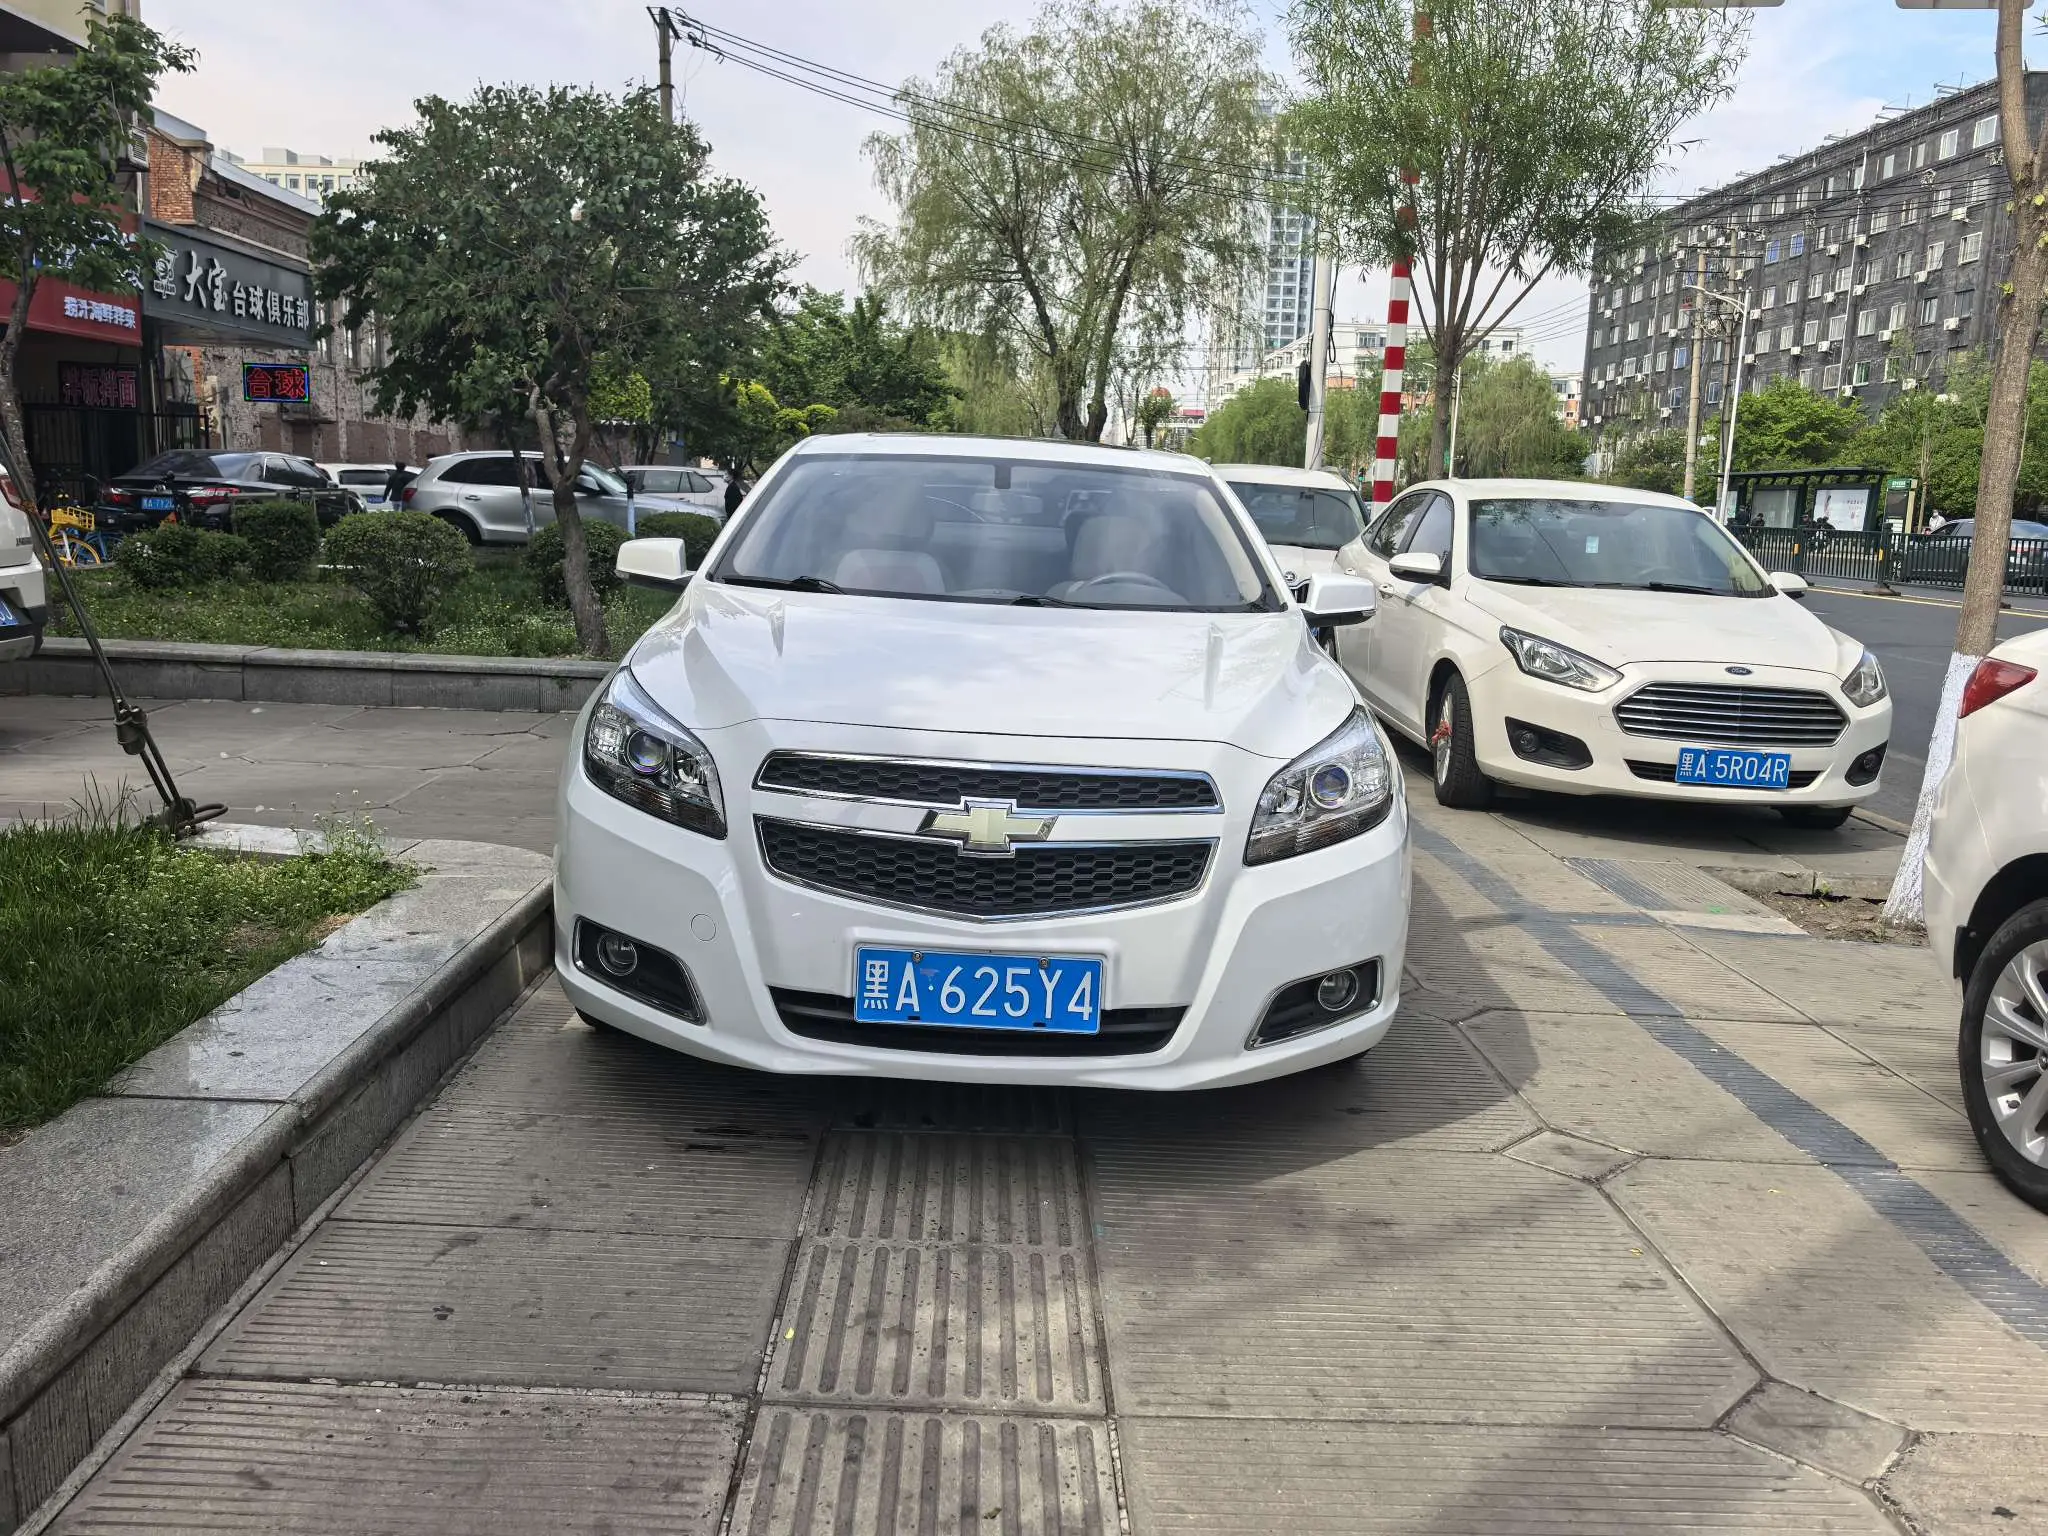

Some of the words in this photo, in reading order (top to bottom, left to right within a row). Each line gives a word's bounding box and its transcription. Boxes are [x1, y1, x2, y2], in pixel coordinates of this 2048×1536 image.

[184, 249, 310, 331] 大宝台球俱乐部
[246, 367, 306, 400] 台球
[1679, 752, 1787, 783] 黑A·5R04R
[863, 959, 1094, 1021] 黑A·625Y4
